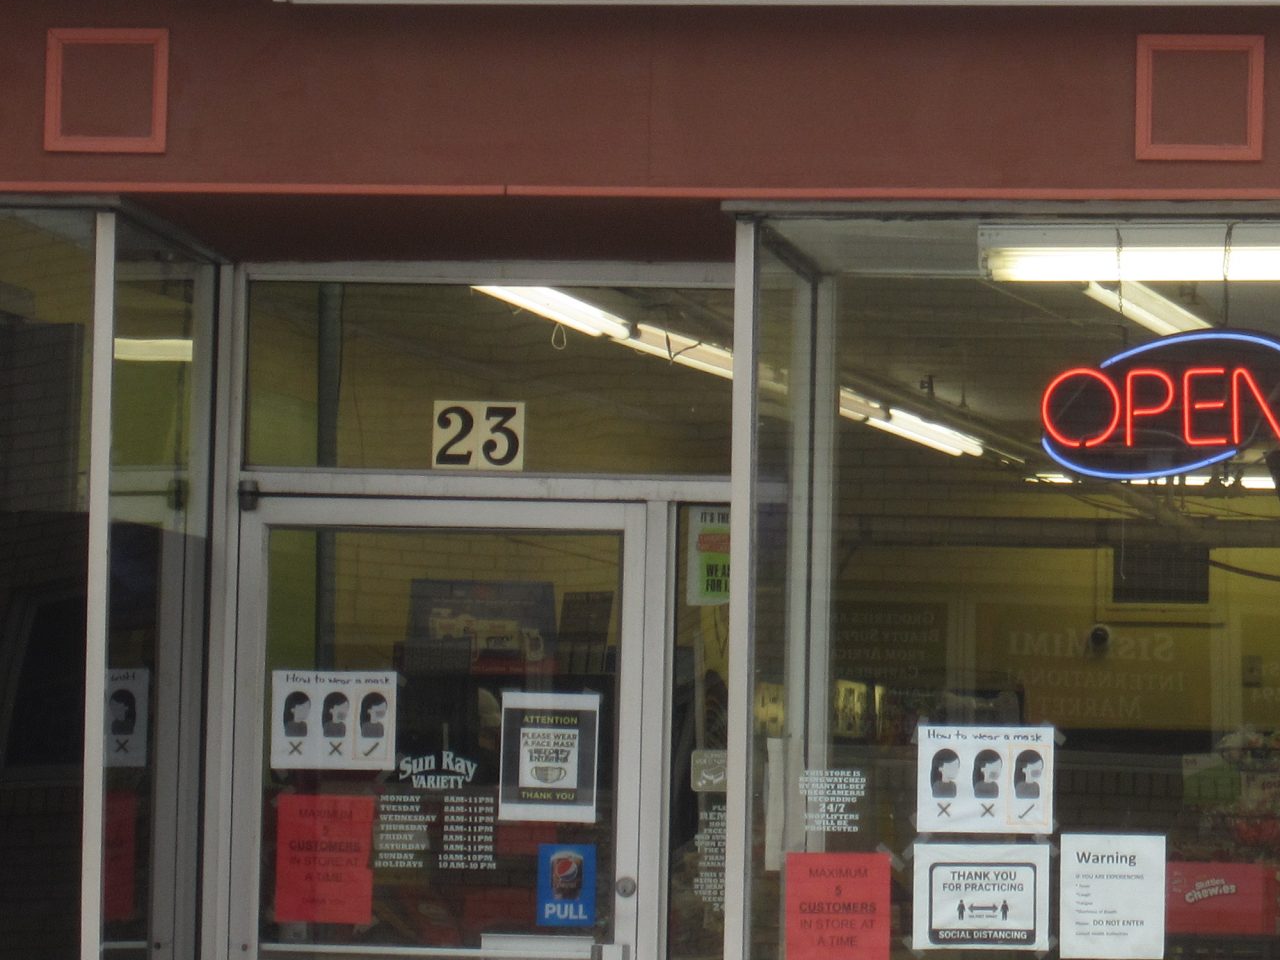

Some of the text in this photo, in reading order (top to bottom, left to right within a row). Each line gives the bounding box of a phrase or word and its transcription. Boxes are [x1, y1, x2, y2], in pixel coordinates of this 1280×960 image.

[436, 406, 519, 466] 23
[286, 674, 310, 684] How
[314, 674, 325, 684] to
[365, 677, 391, 685] mask
[523, 715, 579, 726] ATTENTION
[927, 730, 952, 740] How
[957, 730, 968, 740] to
[972, 732, 1000, 741] wear
[1013, 732, 1043, 741] mask
[399, 751, 478, 782] Sun Ray
[411, 775, 465, 789] VARIETY
[521, 791, 575, 801] THANK YOU
[819, 803, 845, 813] 24/7
[299, 809, 353, 819] MAXIMUM
[289, 840, 361, 852] CUSTOMERS
[1076, 851, 1137, 867] Warning
[808, 867, 868, 879] MAXIMUM
[950, 871, 1017, 882] THANK YOU
[835, 886, 842, 896] 5
[942, 882, 1025, 893] FOR PRACTICING
[544, 903, 588, 920] PULL
[799, 901, 877, 914] CUSTOMERS
[800, 918, 875, 930] IN STORE AT
[1092, 919, 1104, 927] DO
[1105, 919, 1120, 927] NOT
[1121, 919, 1145, 927] ENTER
[938, 930, 1028, 941] SOCIAL DISTANCING
[817, 935, 858, 948] A TIME
